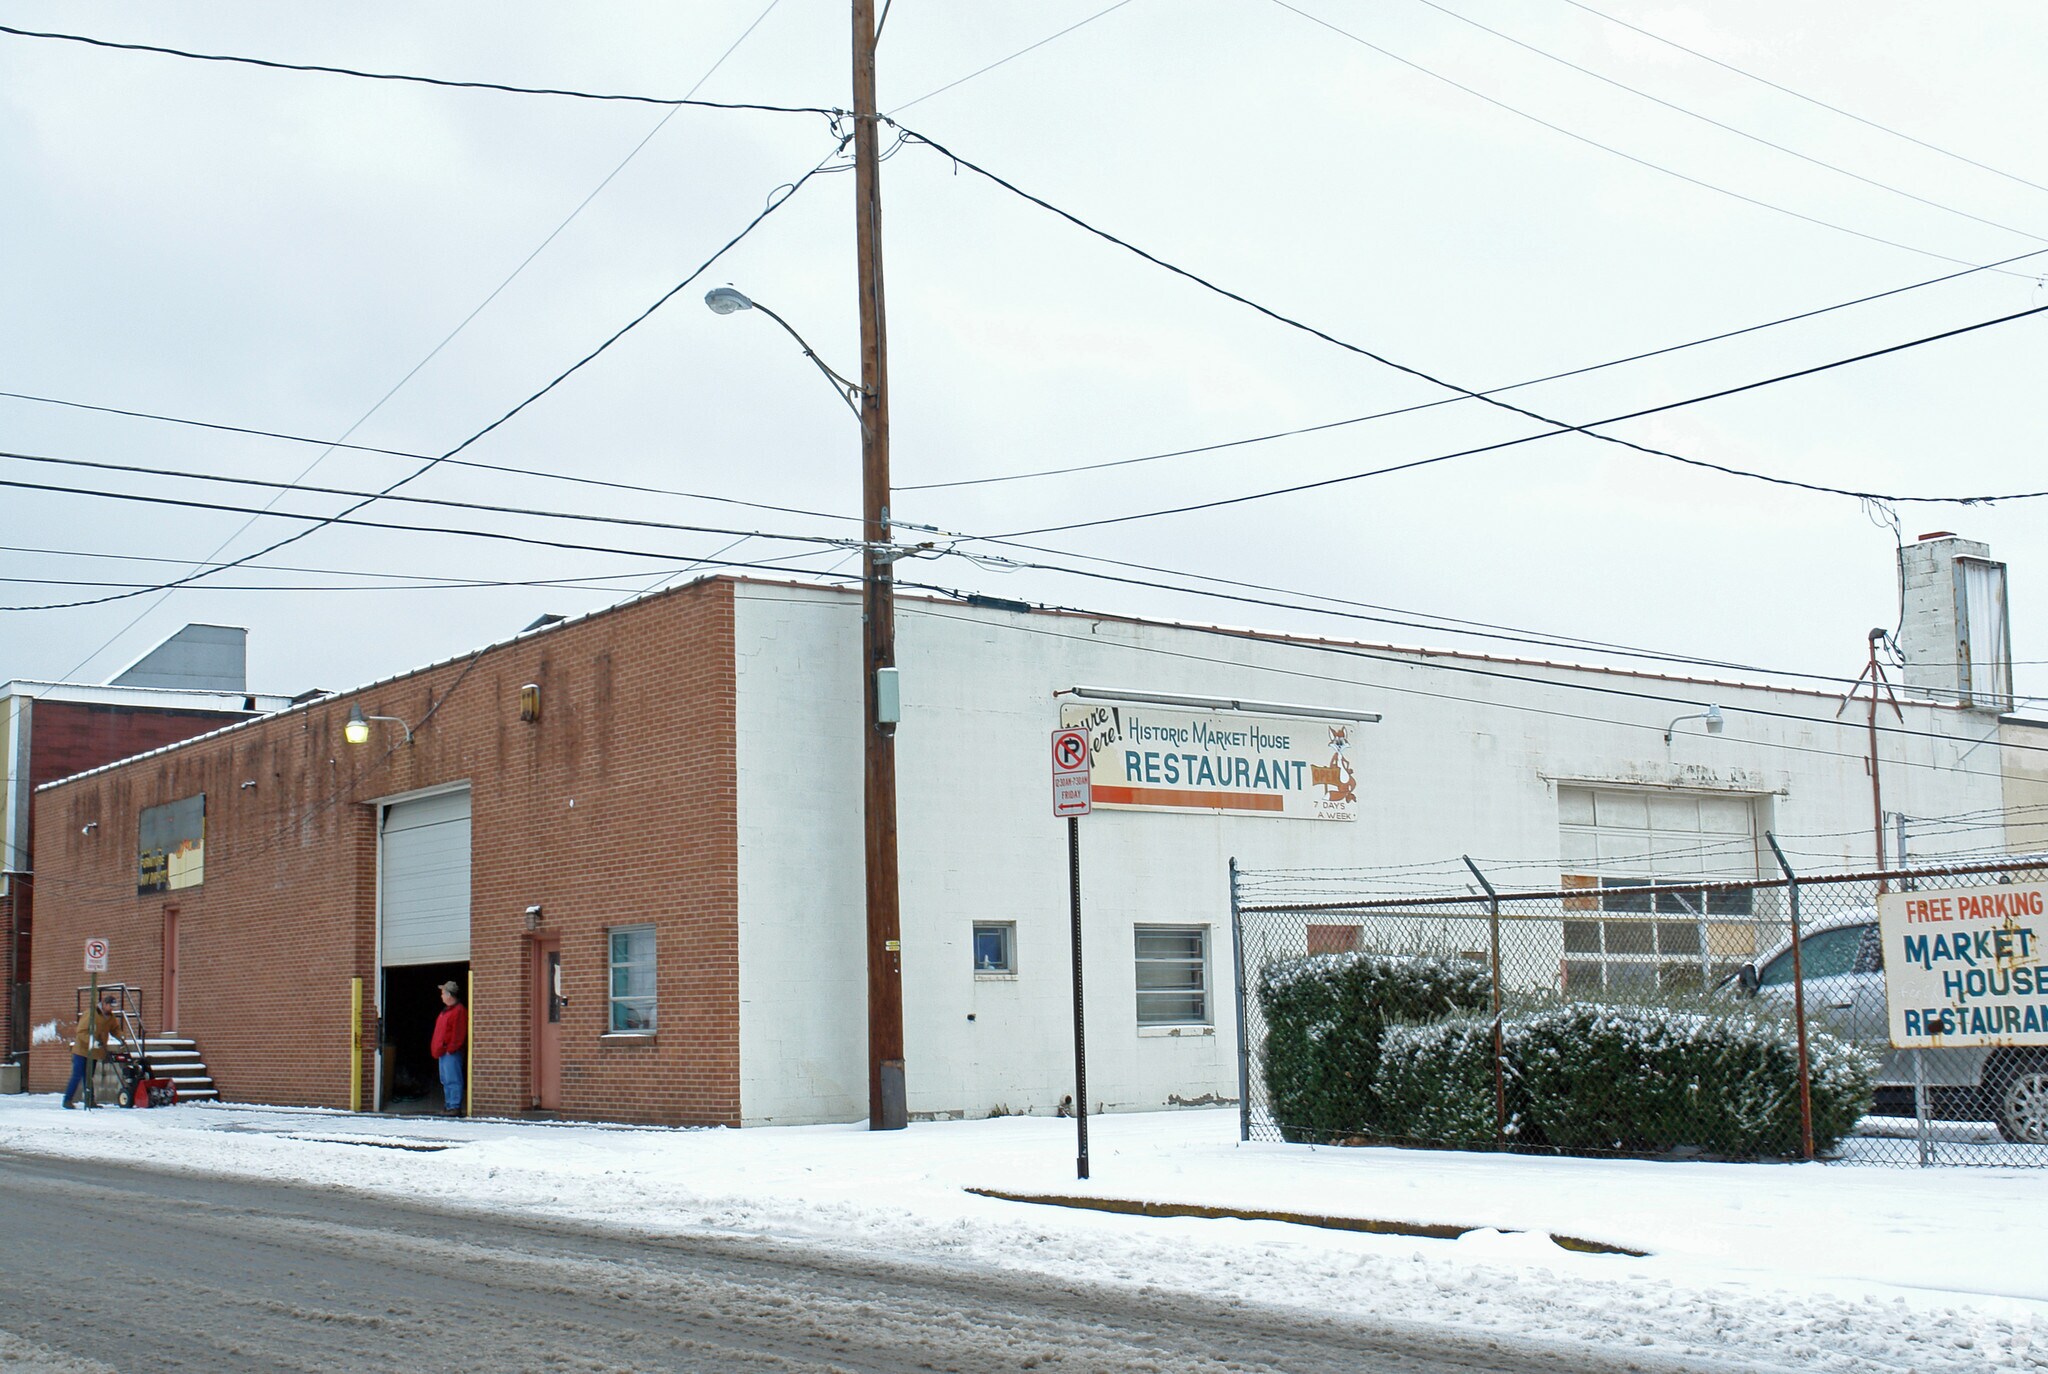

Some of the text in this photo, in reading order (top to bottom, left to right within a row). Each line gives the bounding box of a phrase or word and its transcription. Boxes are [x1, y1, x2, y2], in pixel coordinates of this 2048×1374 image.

[1125, 750, 1307, 791] RESTAURANT
[1313, 768, 1338, 782] OPEN
[1061, 790, 1081, 800] FRIDAY
[1313, 800, 1346, 810] 7 DAYS
[1317, 811, 1352, 820] A WEEK
[1905, 891, 2044, 924] FREE PARKING
[1903, 928, 2032, 971] MARKET
[1943, 966, 2048, 1003] HOUSE
